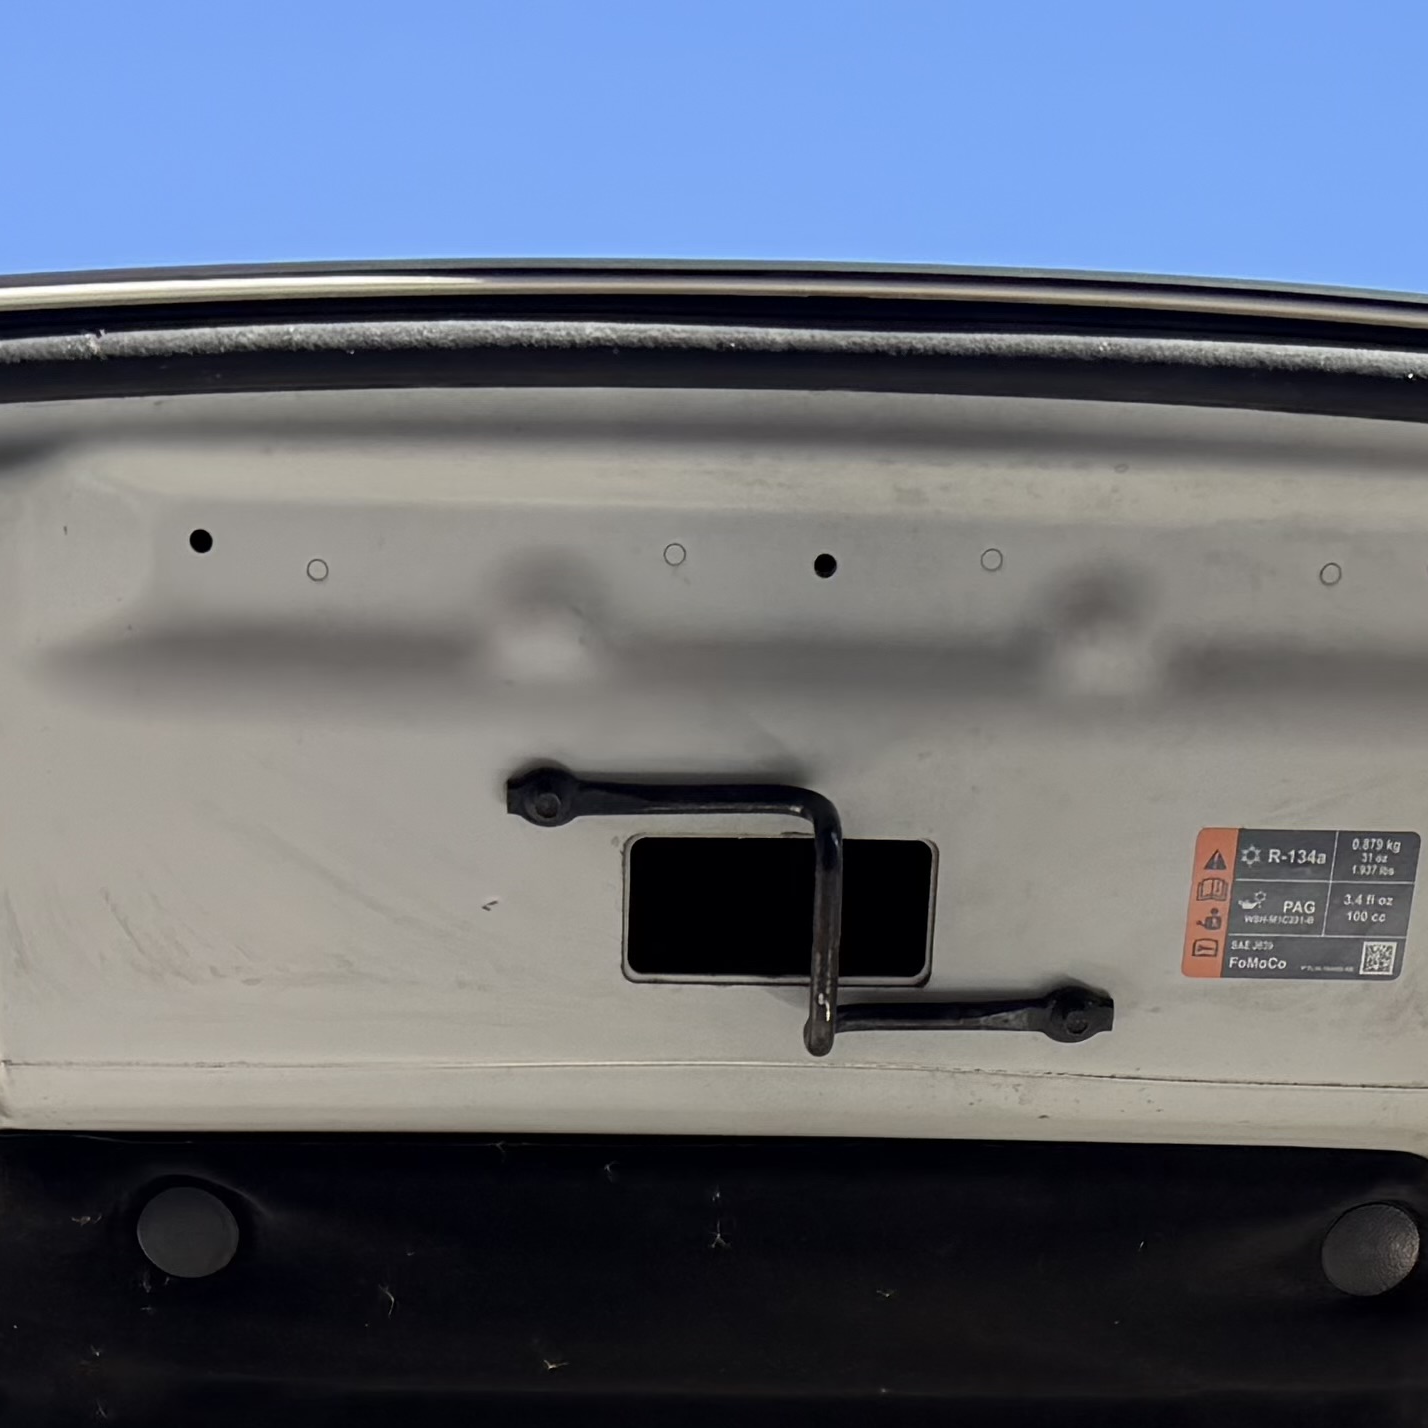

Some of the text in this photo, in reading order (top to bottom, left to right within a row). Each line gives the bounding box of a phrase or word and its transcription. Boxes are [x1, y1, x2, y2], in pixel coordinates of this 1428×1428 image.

[1352, 838, 1402, 853] 0.879 kg
[1268, 849, 1327, 865] R-134a
[1361, 853, 1388, 863] 31 oz
[1378, 865, 1395, 876] lbs
[1343, 894, 1363, 906] 3.4
[1378, 896, 1394, 906] oz
[1283, 900, 1316, 915] PAG
[1347, 911, 1386, 923] 100 cc
[1228, 956, 1287, 970] FoMoCo
